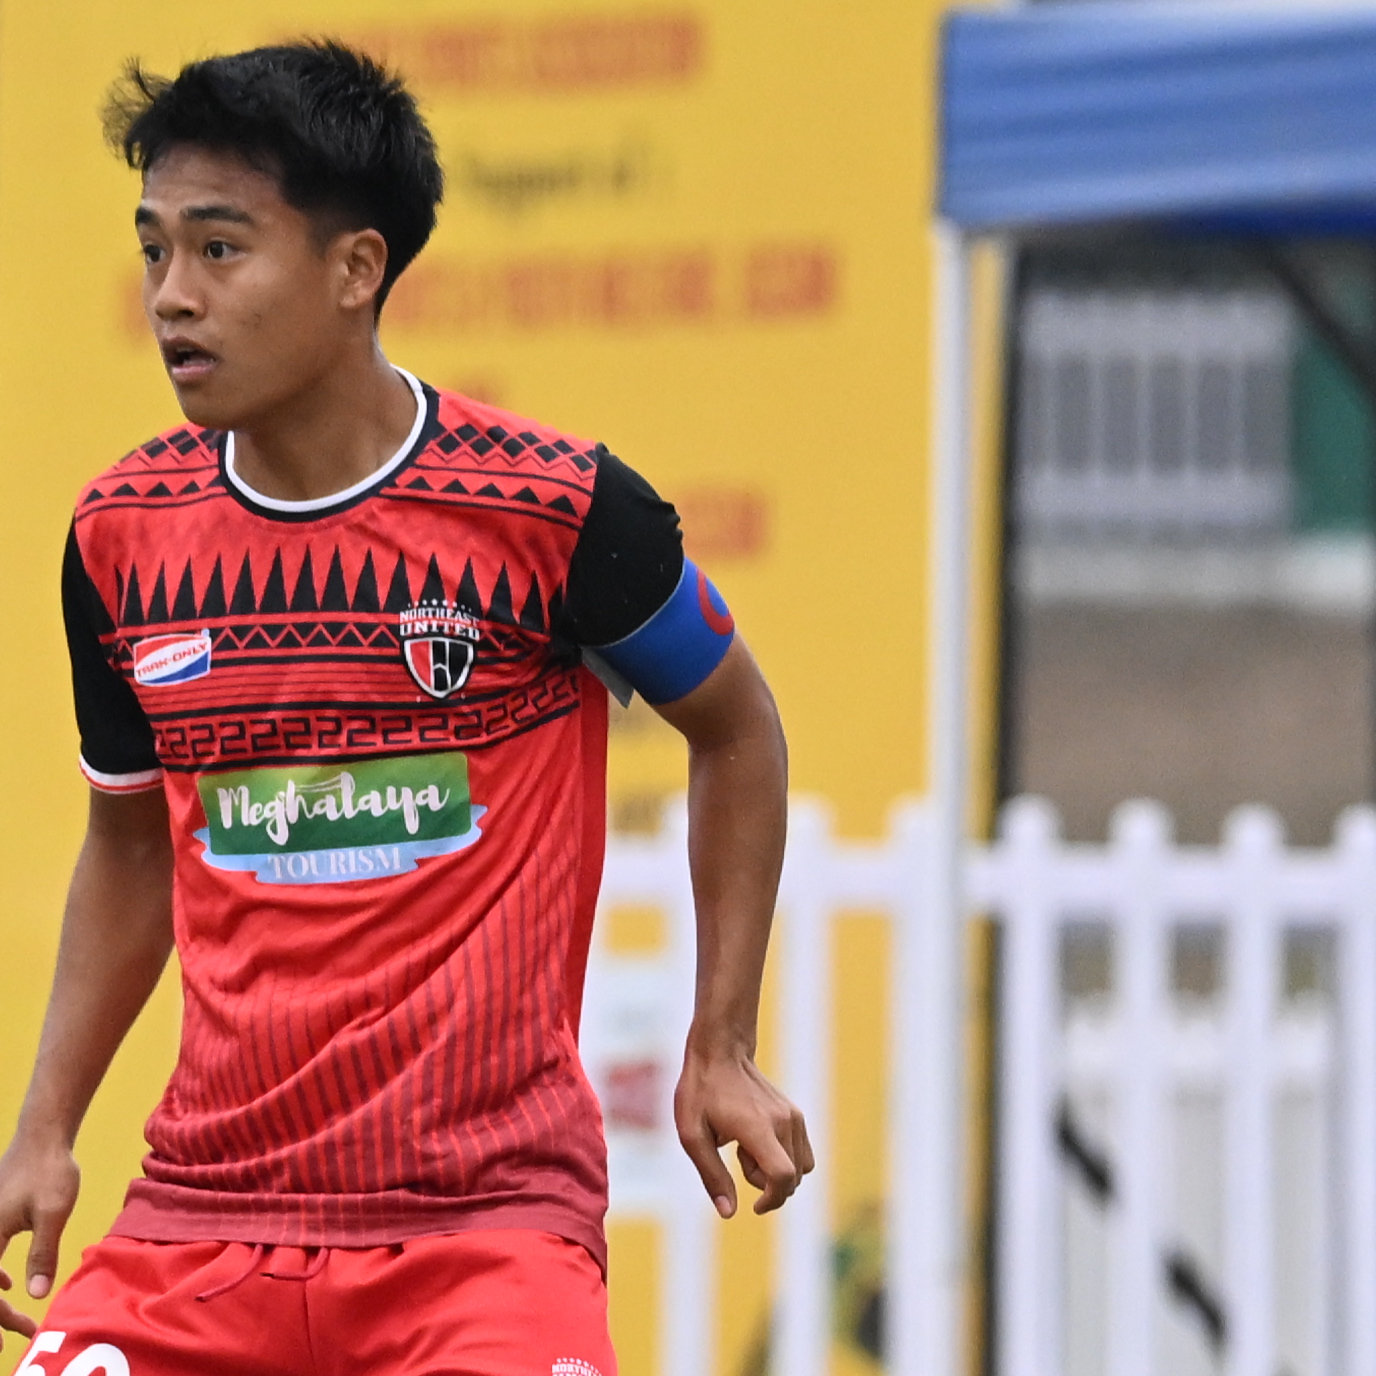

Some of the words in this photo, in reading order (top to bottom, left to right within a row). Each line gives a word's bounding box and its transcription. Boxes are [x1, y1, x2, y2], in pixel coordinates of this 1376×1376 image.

[399, 608, 480, 628] NORTHEAST
[399, 621, 480, 641] UNITED
[217, 772, 450, 845] Meghalaya
[268, 847, 402, 880] TOURISM
